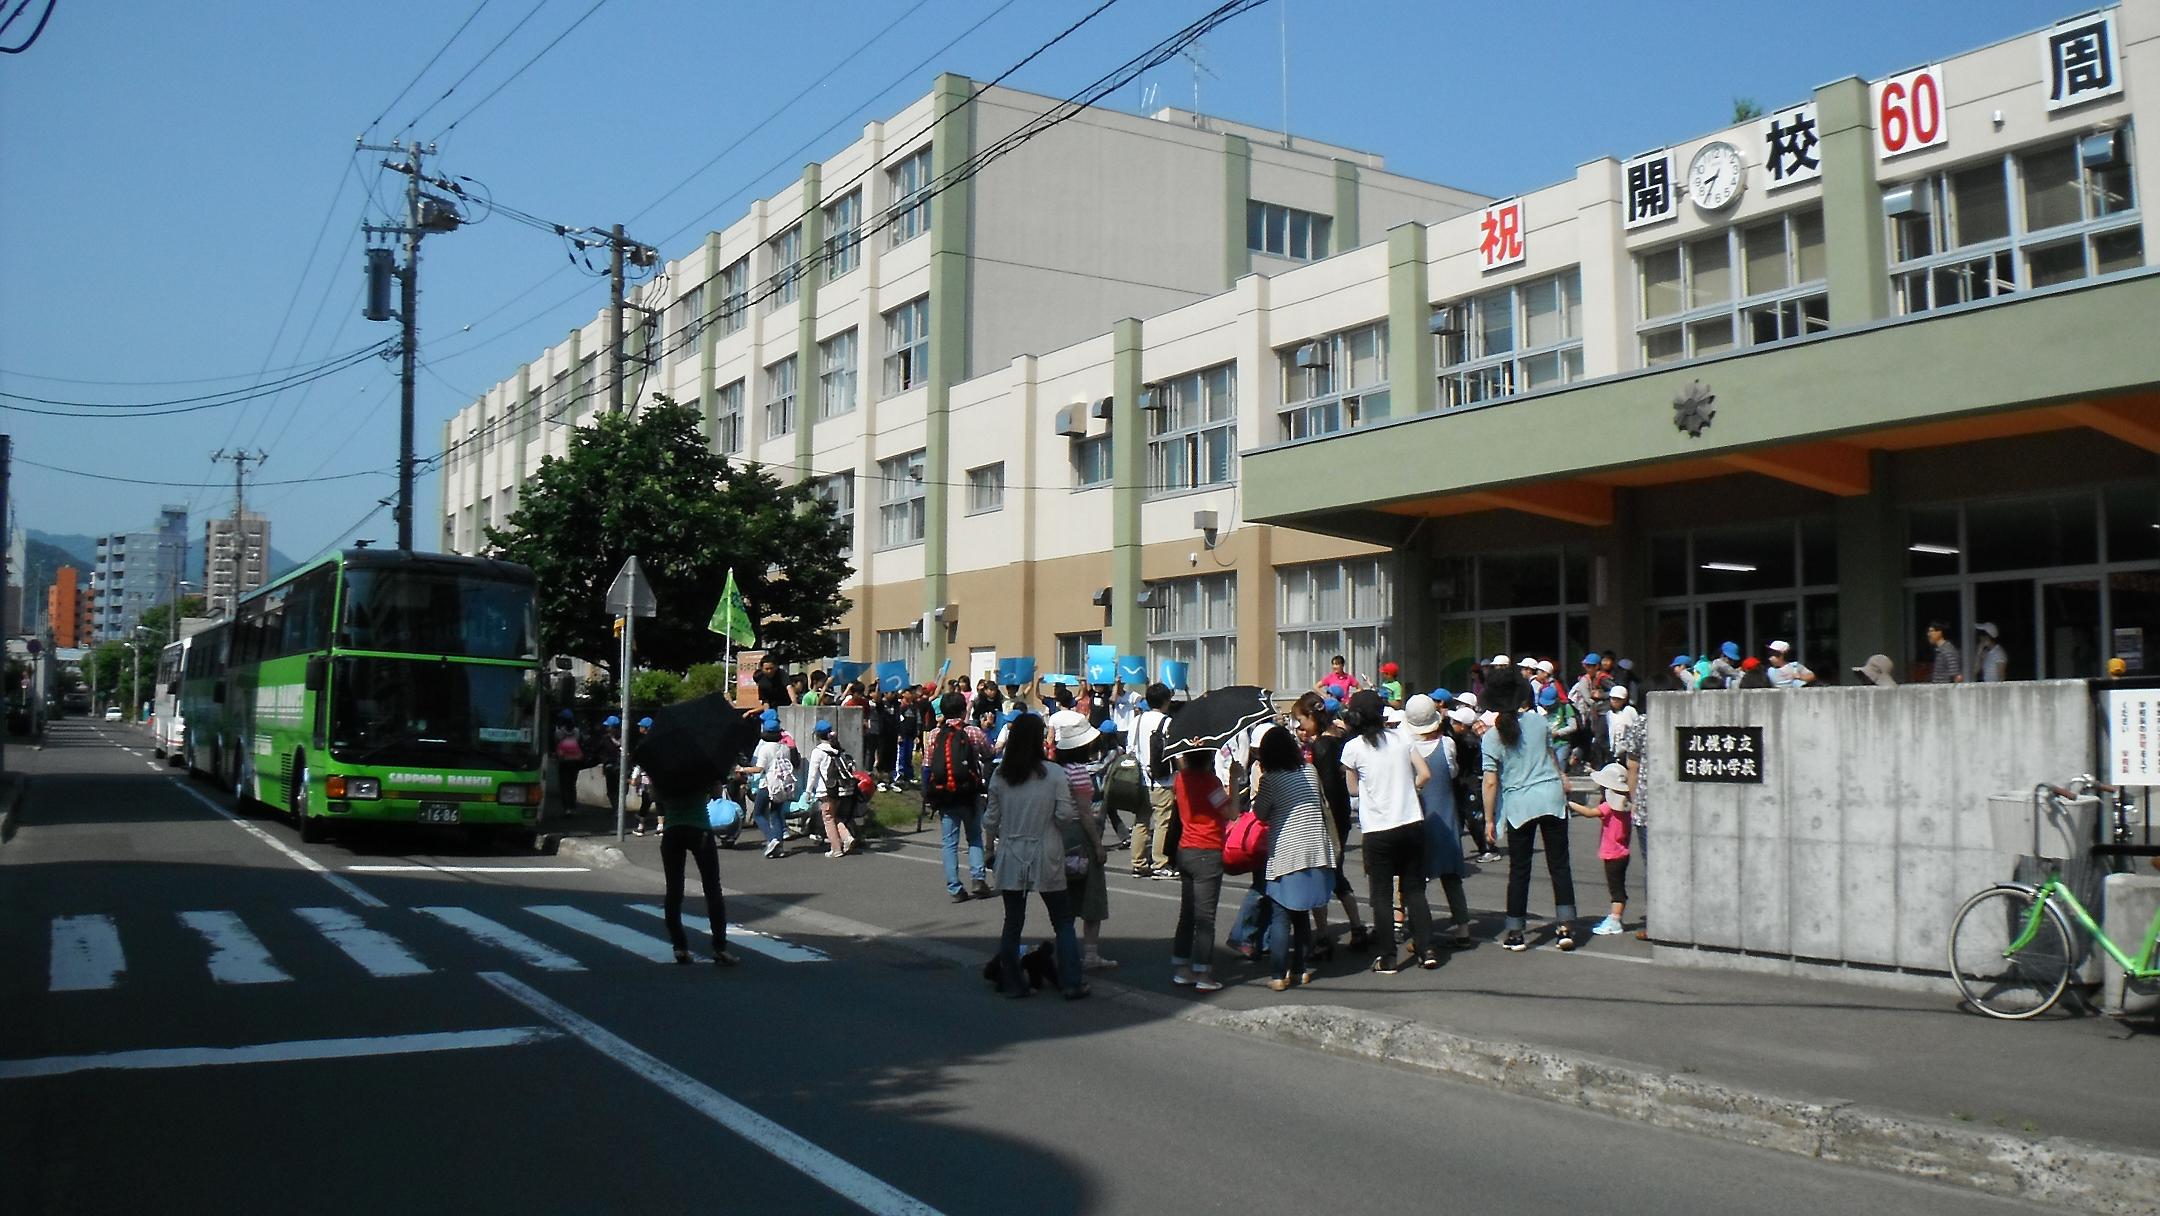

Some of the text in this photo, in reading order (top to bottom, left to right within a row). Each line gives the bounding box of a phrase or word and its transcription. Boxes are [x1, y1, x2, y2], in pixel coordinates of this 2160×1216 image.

[1480, 19, 2112, 265] 祝 開 校 60 周
[1689, 734, 1754, 752] 札幌市立
[1685, 757, 1757, 776] 日新小学校
[388, 772, 443, 784] SAPPORO
